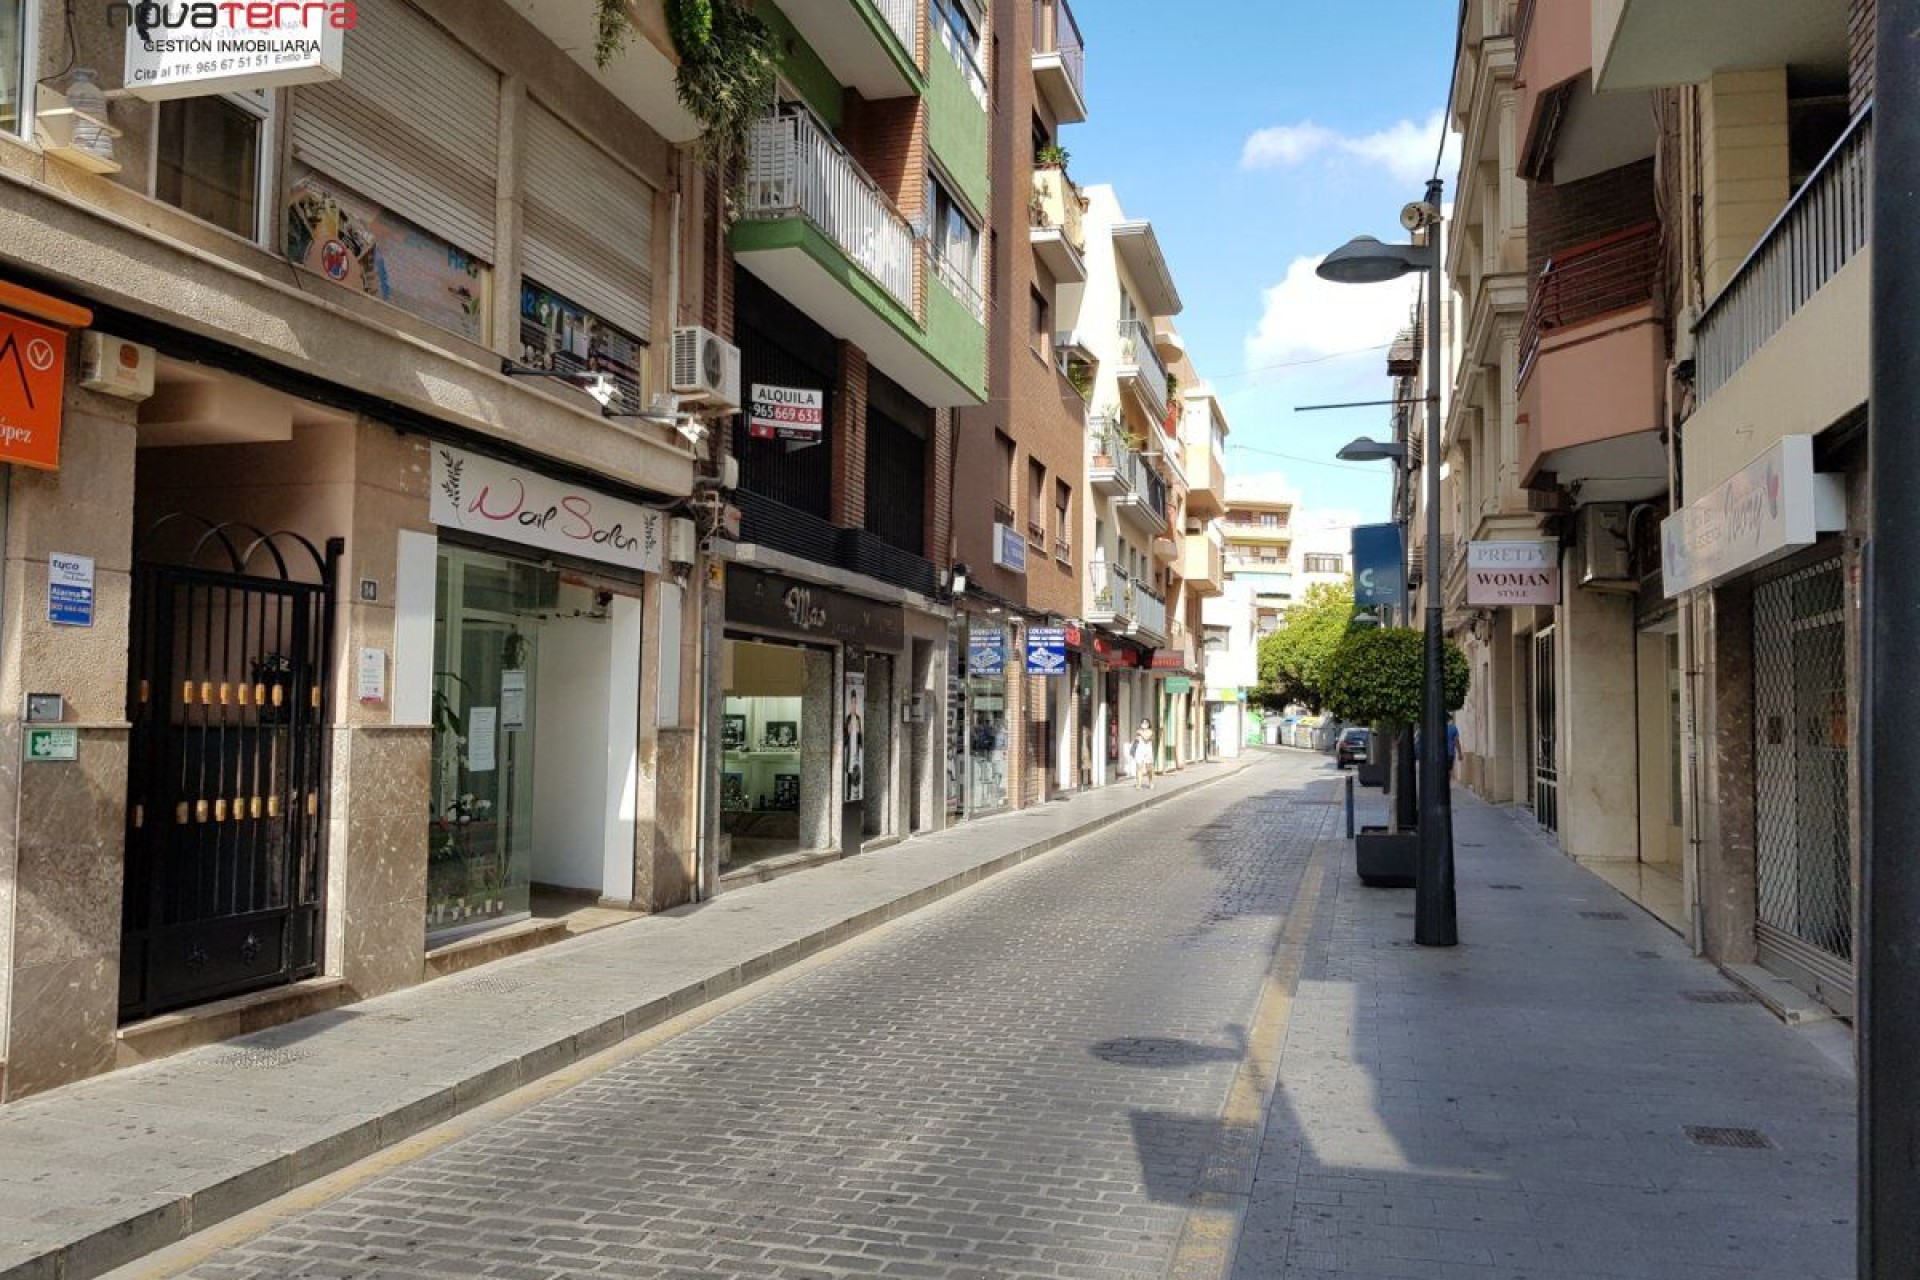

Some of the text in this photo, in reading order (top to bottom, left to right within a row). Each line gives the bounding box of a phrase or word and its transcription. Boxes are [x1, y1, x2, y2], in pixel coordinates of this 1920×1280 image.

[134, 67, 157, 81] Cita
[161, 67, 171, 78] al
[196, 60, 217, 74] 965
[220, 59, 234, 71] 67
[238, 57, 251, 68] 51
[255, 55, 269, 66] 51
[758, 387, 815, 404] ALQUILA
[753, 404, 774, 419] 965
[775, 406, 796, 420] 669
[468, 478, 638, 551] Nail Salon
[1477, 548, 1548, 561] PRETTY
[1477, 573, 1550, 586] WOMAN
[1497, 590, 1527, 598] STYLE
